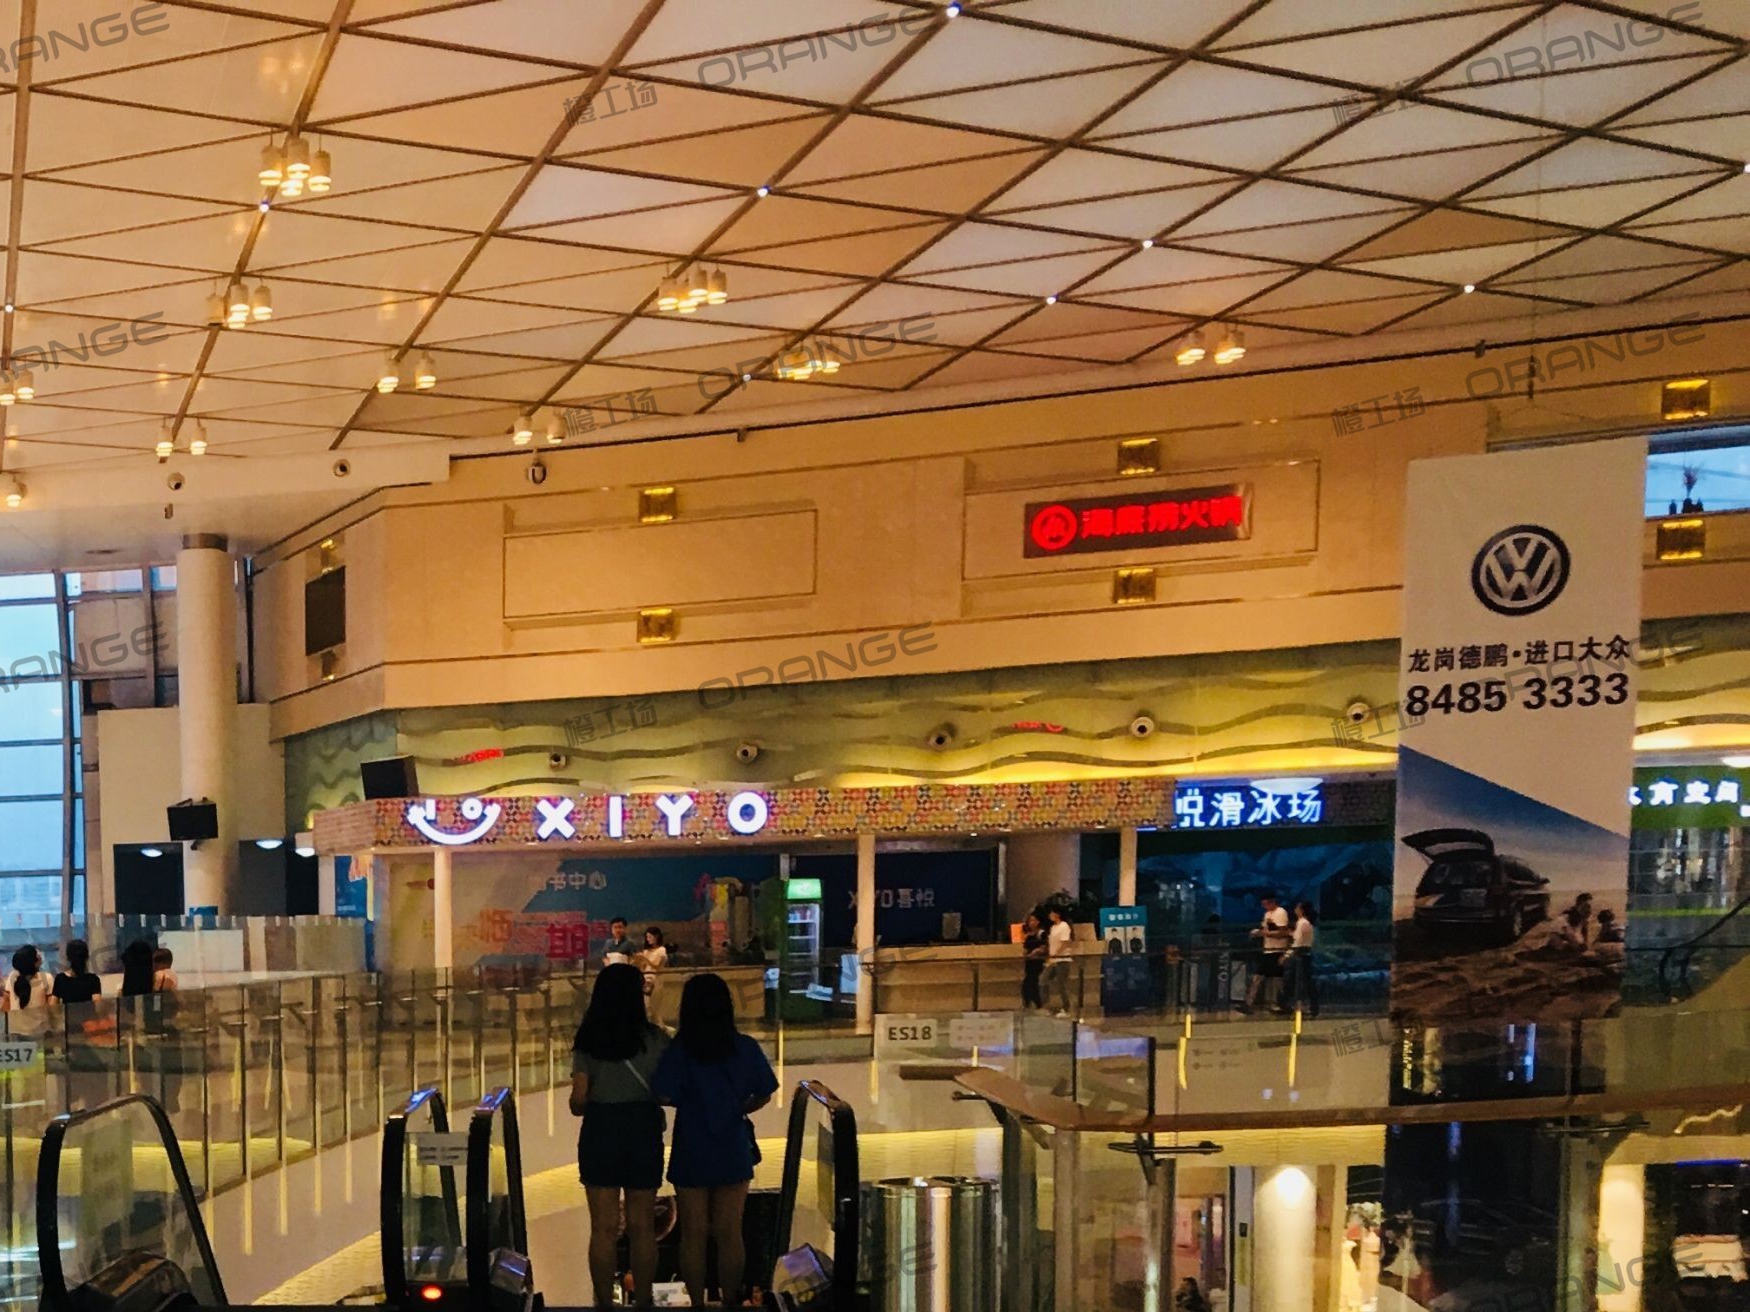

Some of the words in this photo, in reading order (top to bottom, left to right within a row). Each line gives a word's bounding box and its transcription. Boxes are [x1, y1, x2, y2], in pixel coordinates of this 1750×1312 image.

[1406, 681, 1507, 716] 8485
[1523, 673, 1629, 710] 3333
[535, 791, 769, 840] XIYO
[888, 1026, 932, 1040] ES18
